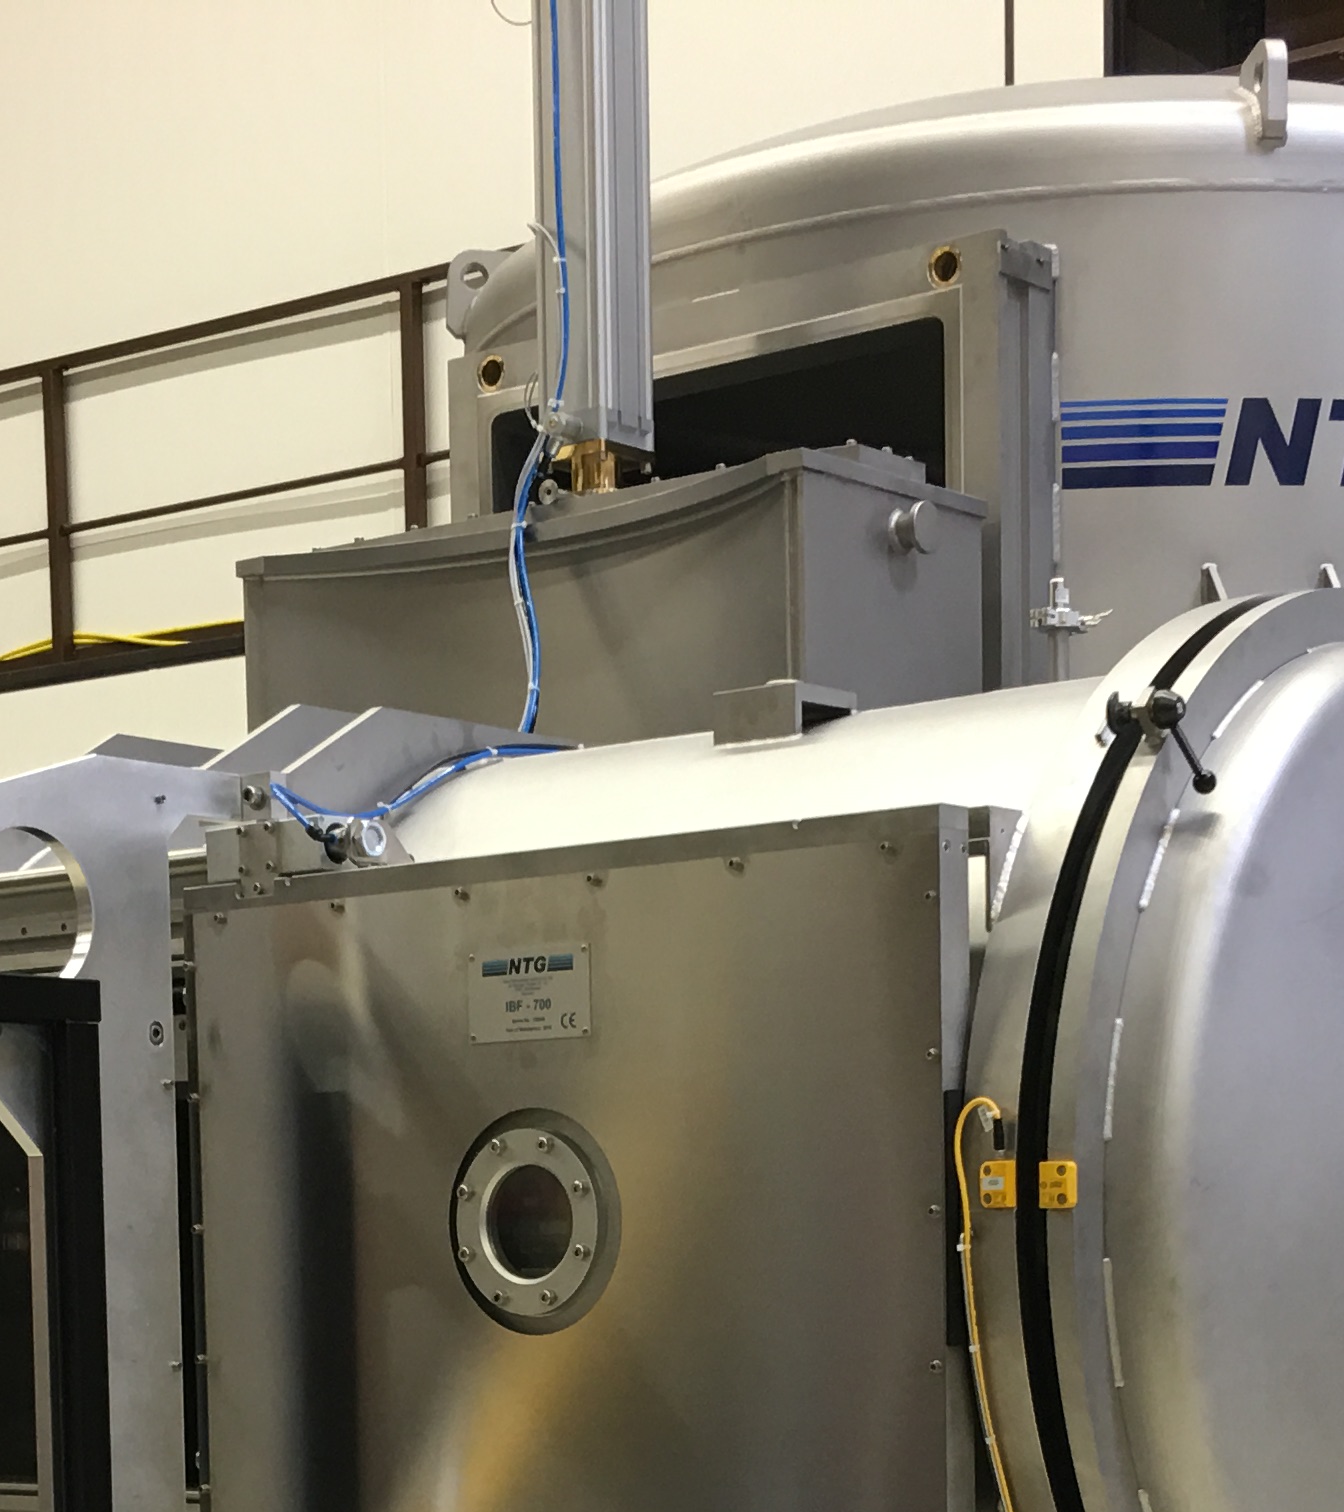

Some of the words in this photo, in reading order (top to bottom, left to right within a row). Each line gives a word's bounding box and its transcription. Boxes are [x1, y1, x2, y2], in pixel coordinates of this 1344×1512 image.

[508, 955, 547, 975] NTG
[505, 999, 523, 1013] IBF
[533, 998, 552, 1011] 700
